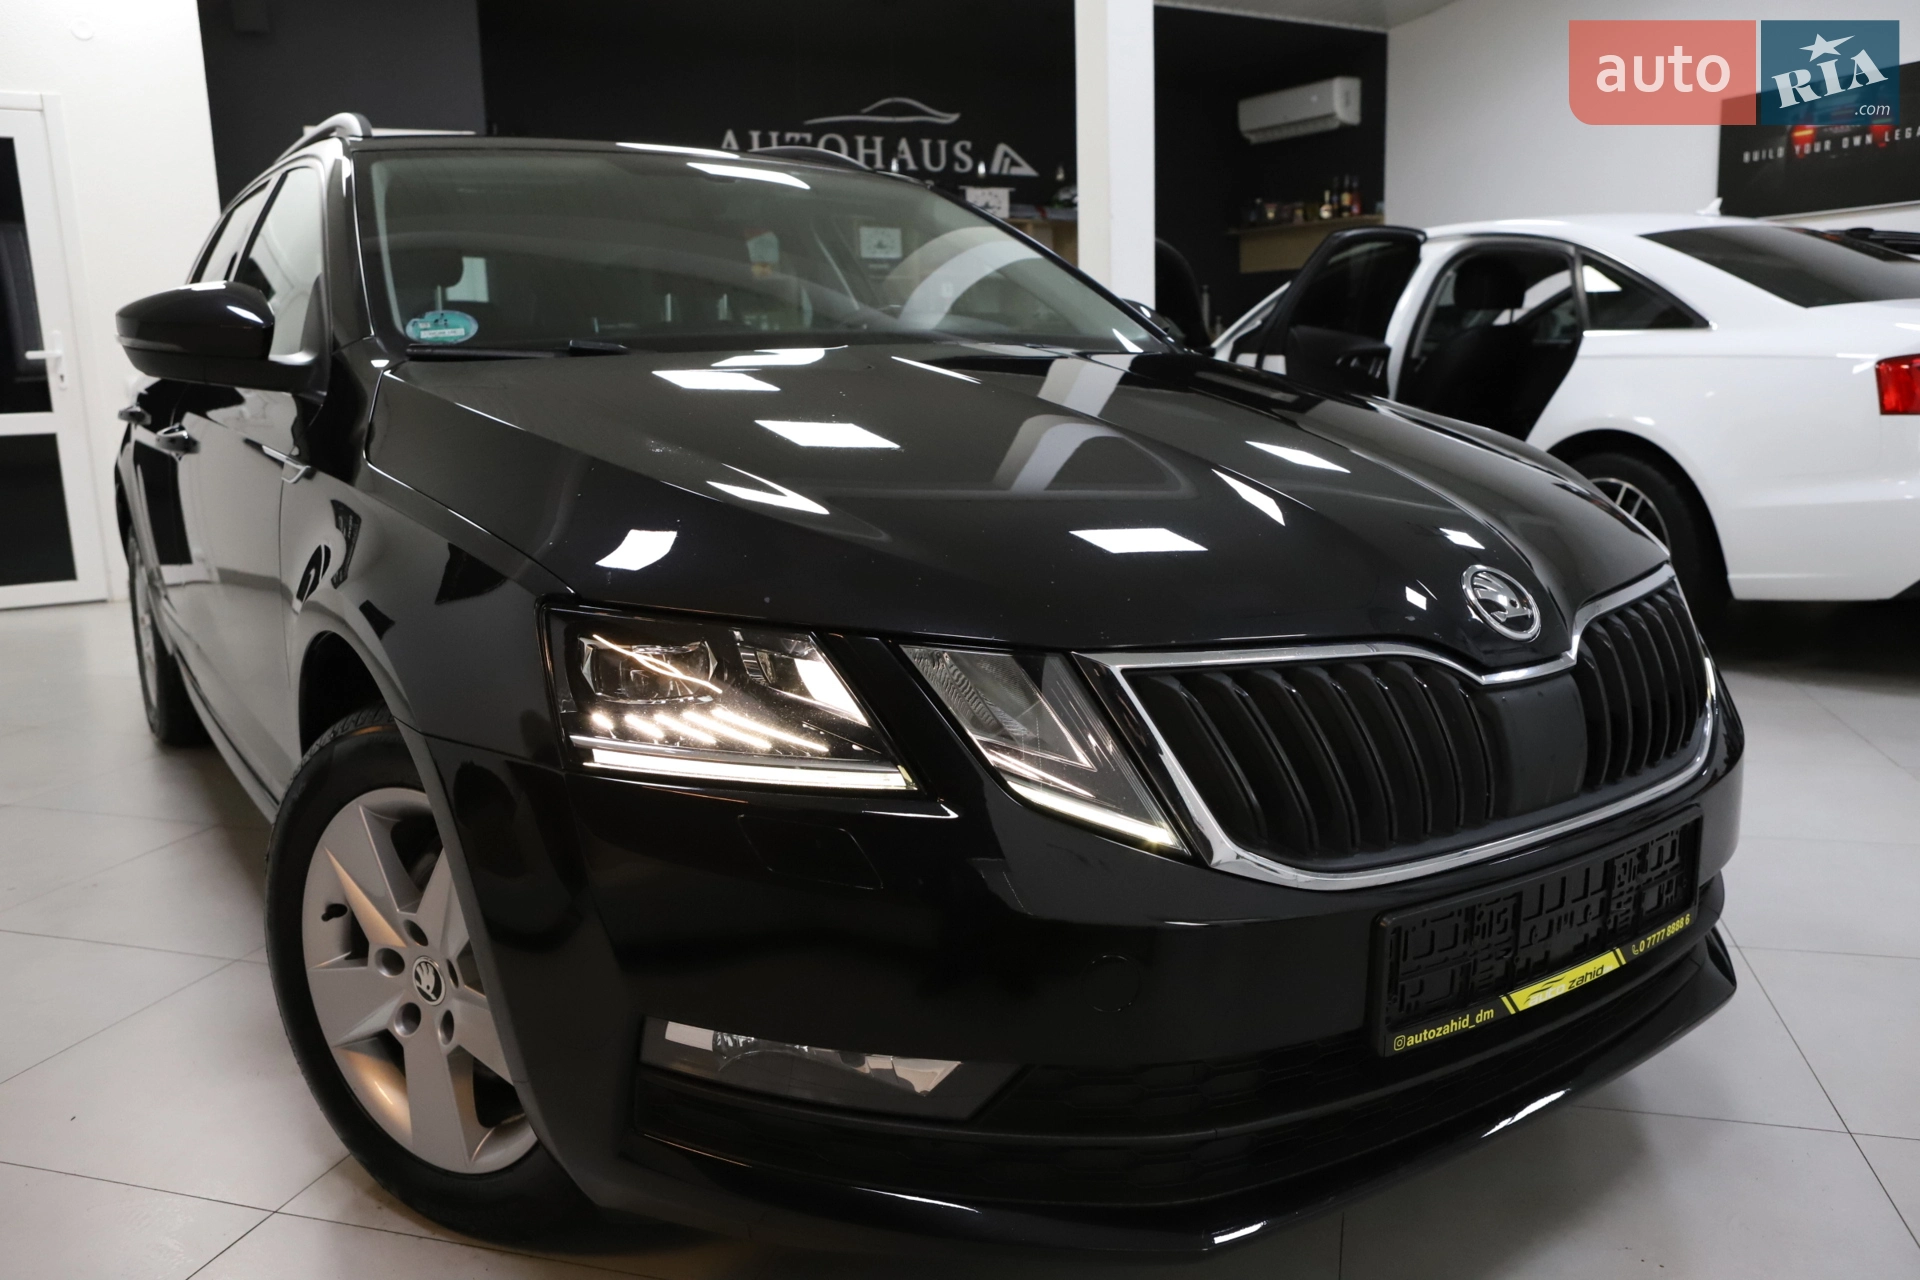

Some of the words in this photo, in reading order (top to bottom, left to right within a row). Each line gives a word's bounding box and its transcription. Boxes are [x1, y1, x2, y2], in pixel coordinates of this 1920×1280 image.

[1742, 146, 1786, 164] BUILD
[1794, 139, 1832, 156] YOUR
[1841, 133, 1873, 149] OWN
[1639, 939, 1646, 953] 0
[1567, 964, 1605, 990] zahid
[1406, 1008, 1494, 1047] autozahid_dm
